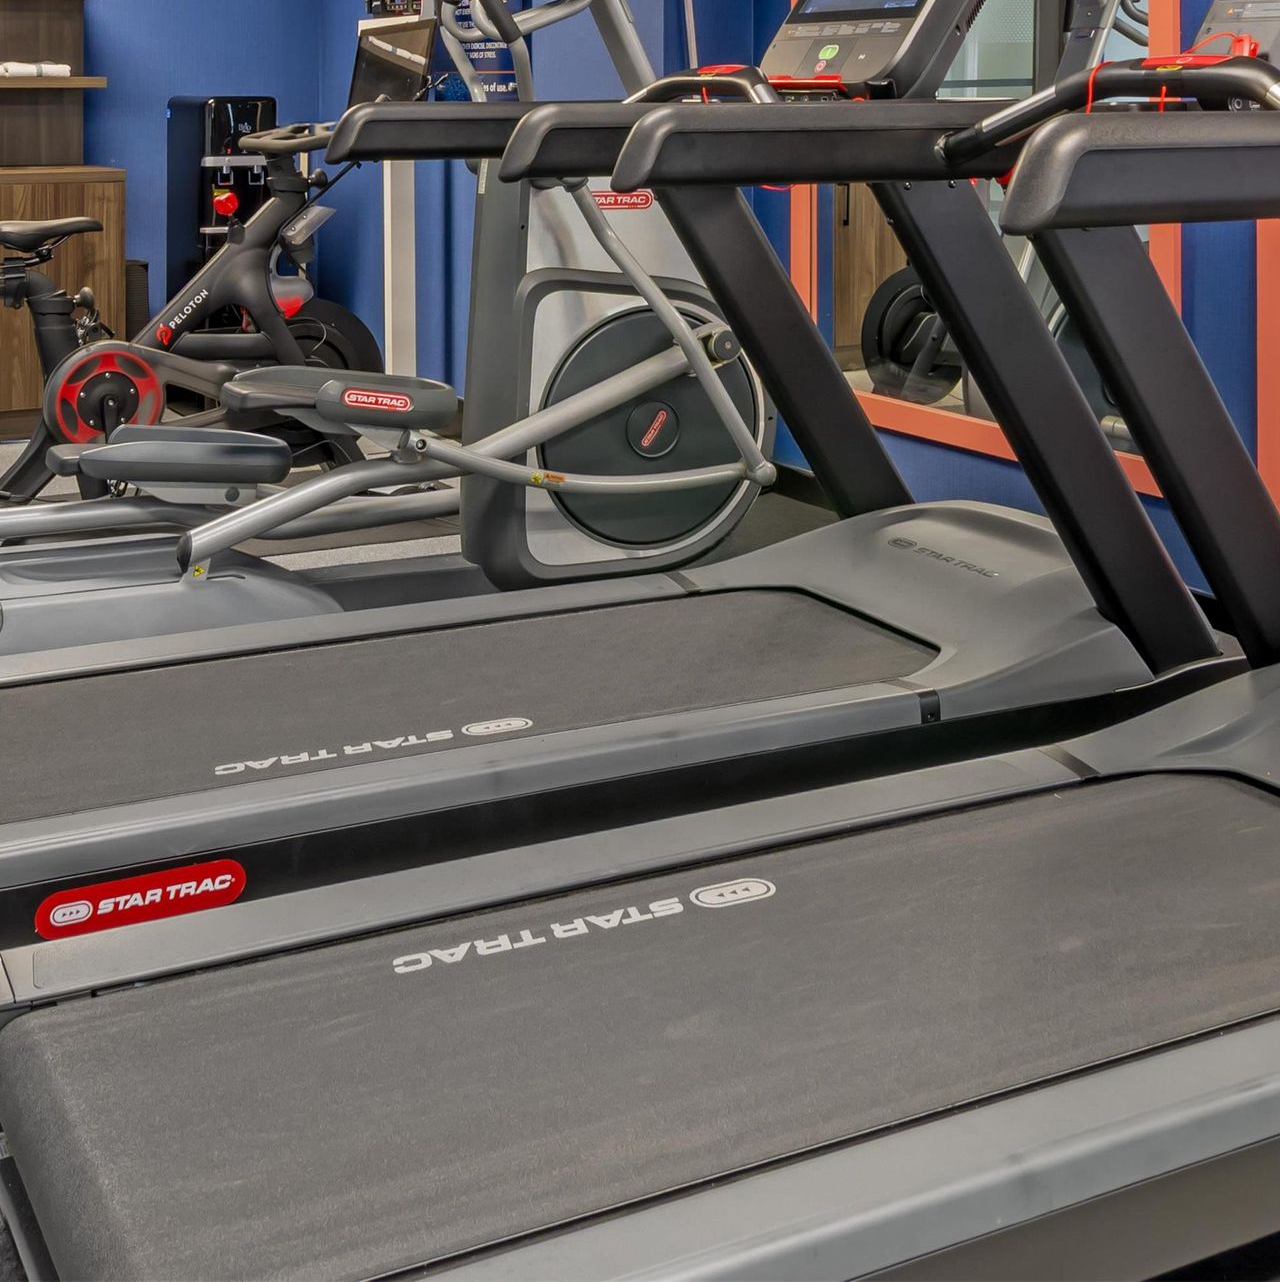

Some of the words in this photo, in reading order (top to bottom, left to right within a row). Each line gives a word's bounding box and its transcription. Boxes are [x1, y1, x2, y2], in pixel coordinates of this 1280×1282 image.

[616, 196, 646, 204] TRAC
[168, 288, 209, 330] PELOTON
[348, 394, 376, 404] STAR
[377, 398, 406, 407] TRAC
[344, 729, 454, 755] STAR
[214, 749, 337, 776] TRAC
[97, 888, 163, 915] STAR
[166, 874, 232, 900] TRAC
[550, 897, 684, 939] STAR
[392, 929, 546, 974] TRAC
